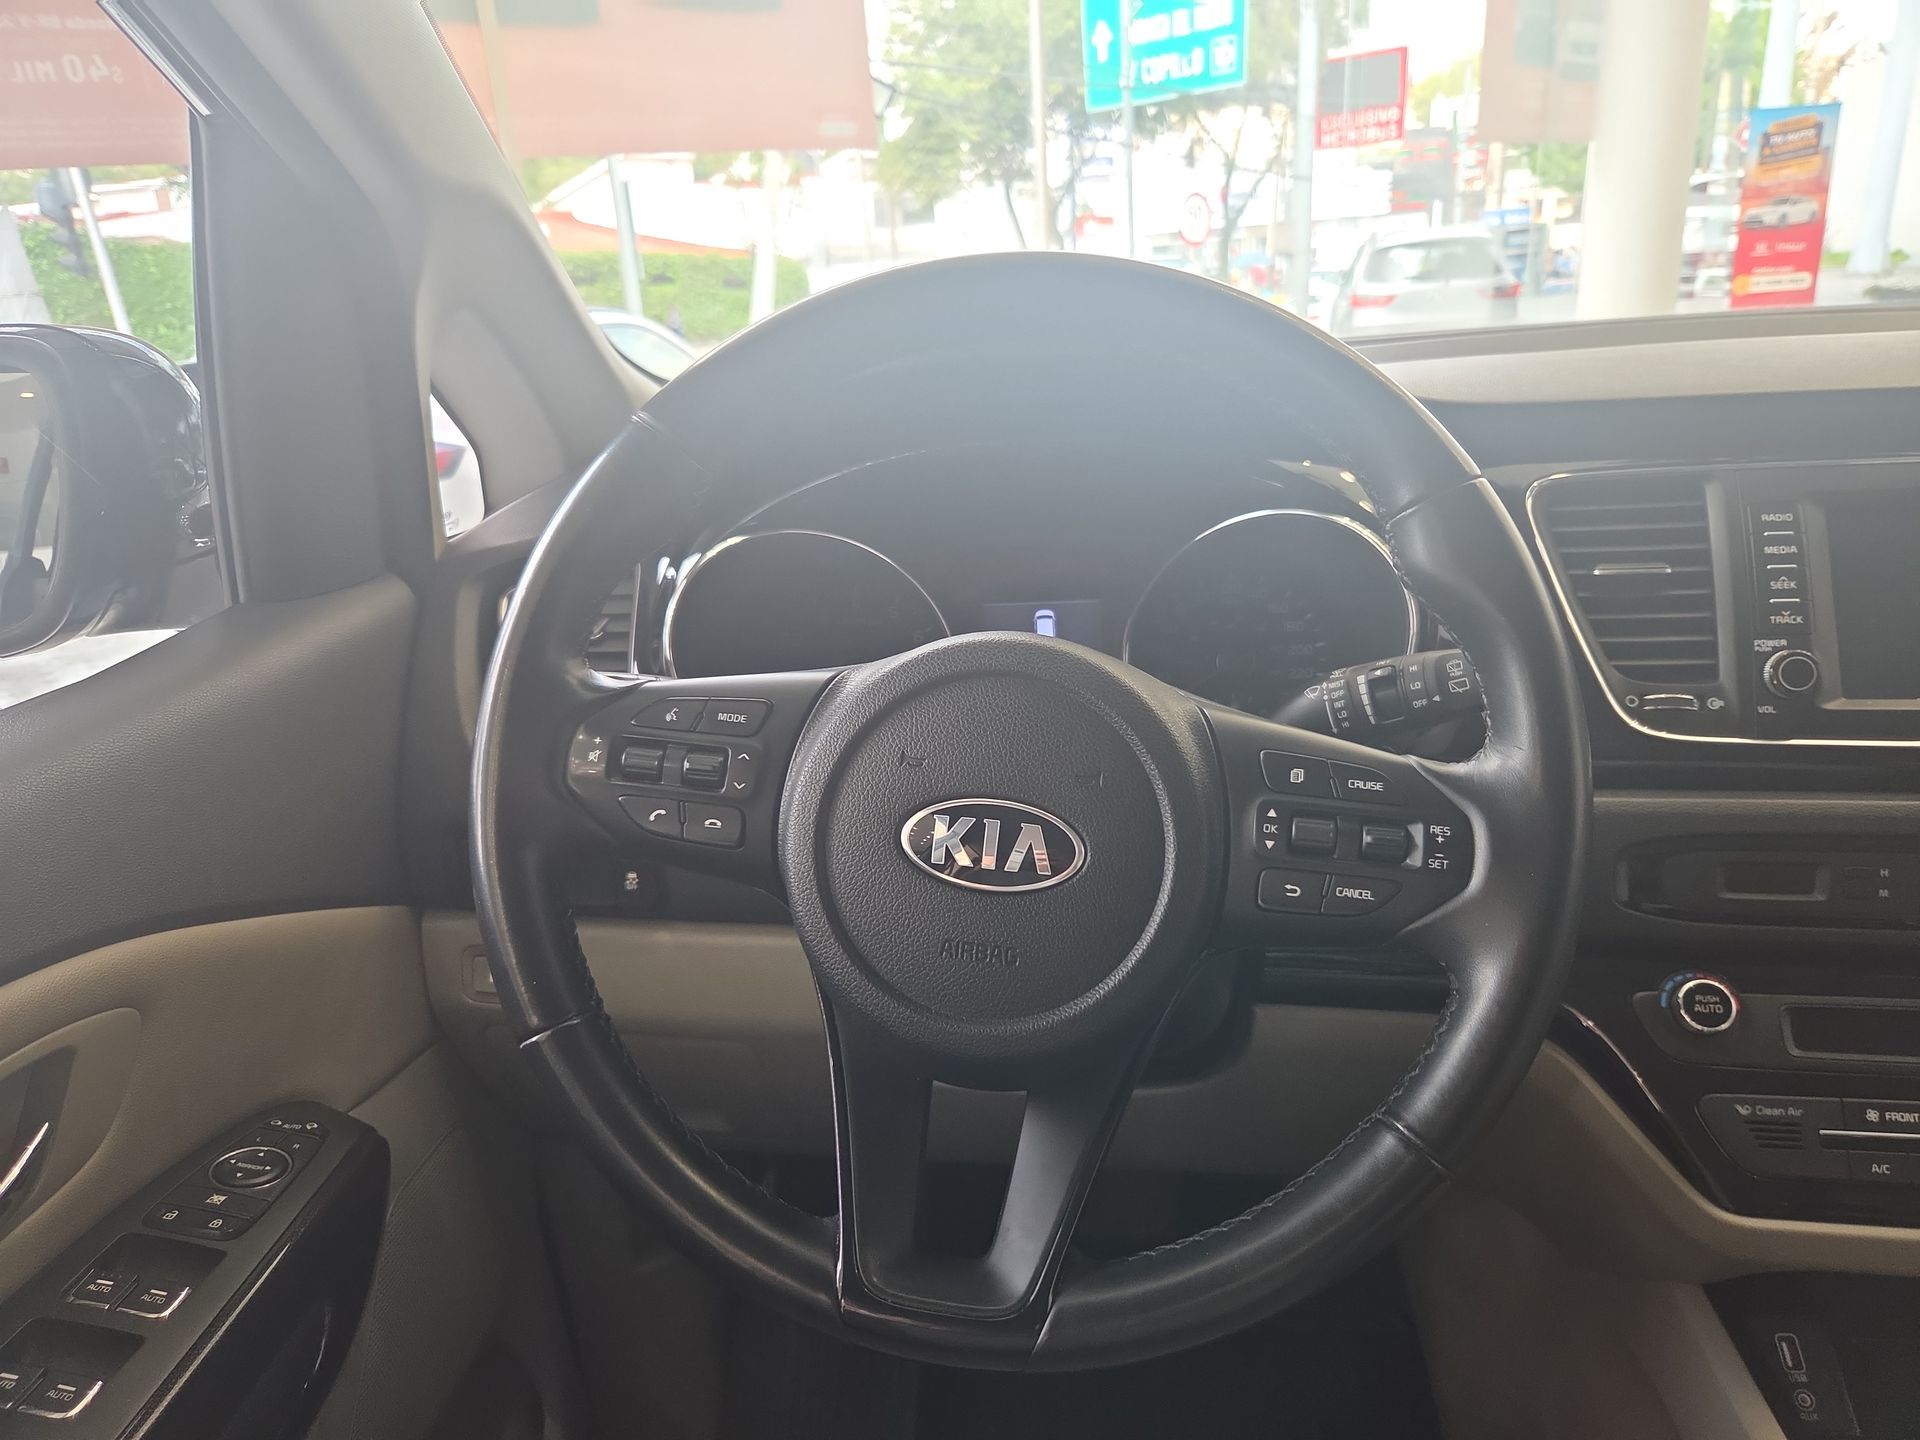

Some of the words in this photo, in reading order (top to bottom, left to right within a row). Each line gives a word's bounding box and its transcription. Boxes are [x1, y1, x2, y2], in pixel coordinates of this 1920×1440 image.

[1761, 513, 1793, 522] RADIO
[1763, 546, 1798, 555] MEDIA
[1770, 580, 1798, 590] SEEK
[1769, 615, 1804, 625] TRACK
[1283, 621, 1304, 632] 180
[1754, 639, 1787, 647] POWER
[1288, 644, 1313, 655] 200
[1288, 668, 1313, 679] 220
[1409, 664, 1418, 673] HI
[1328, 680, 1345, 688] MIST
[1410, 682, 1421, 690] LO
[1330, 690, 1345, 700] OFF
[1333, 700, 1345, 709] INT
[1412, 698, 1428, 709] OFF
[1337, 710, 1347, 719] LO
[1758, 705, 1776, 714] VOL
[717, 712, 748, 724] MODE
[1341, 720, 1350, 729] HI
[1347, 779, 1384, 792] CRUISE
[1263, 824, 1278, 834] OK
[1430, 825, 1450, 836] RES
[930, 814, 1052, 875] KIA
[1428, 858, 1449, 870] SET
[1880, 868, 1889, 877] H
[1335, 887, 1375, 901] CANCEL
[939, 938, 1020, 967] AIRBAG
[1695, 995, 1720, 1003] PUSH
[1694, 1004, 1724, 1013] AUTO
[1755, 1105, 1785, 1117] Clean
[1788, 1106, 1803, 1117] Air
[1885, 1112, 1920, 1122] FRONT
[1872, 1164, 1890, 1174] A/C
[86, 1283, 112, 1294] AUTO
[140, 1293, 166, 1304] AUTO
[1789, 1374, 1808, 1383] USB
[45, 1389, 74, 1402] AUTO
